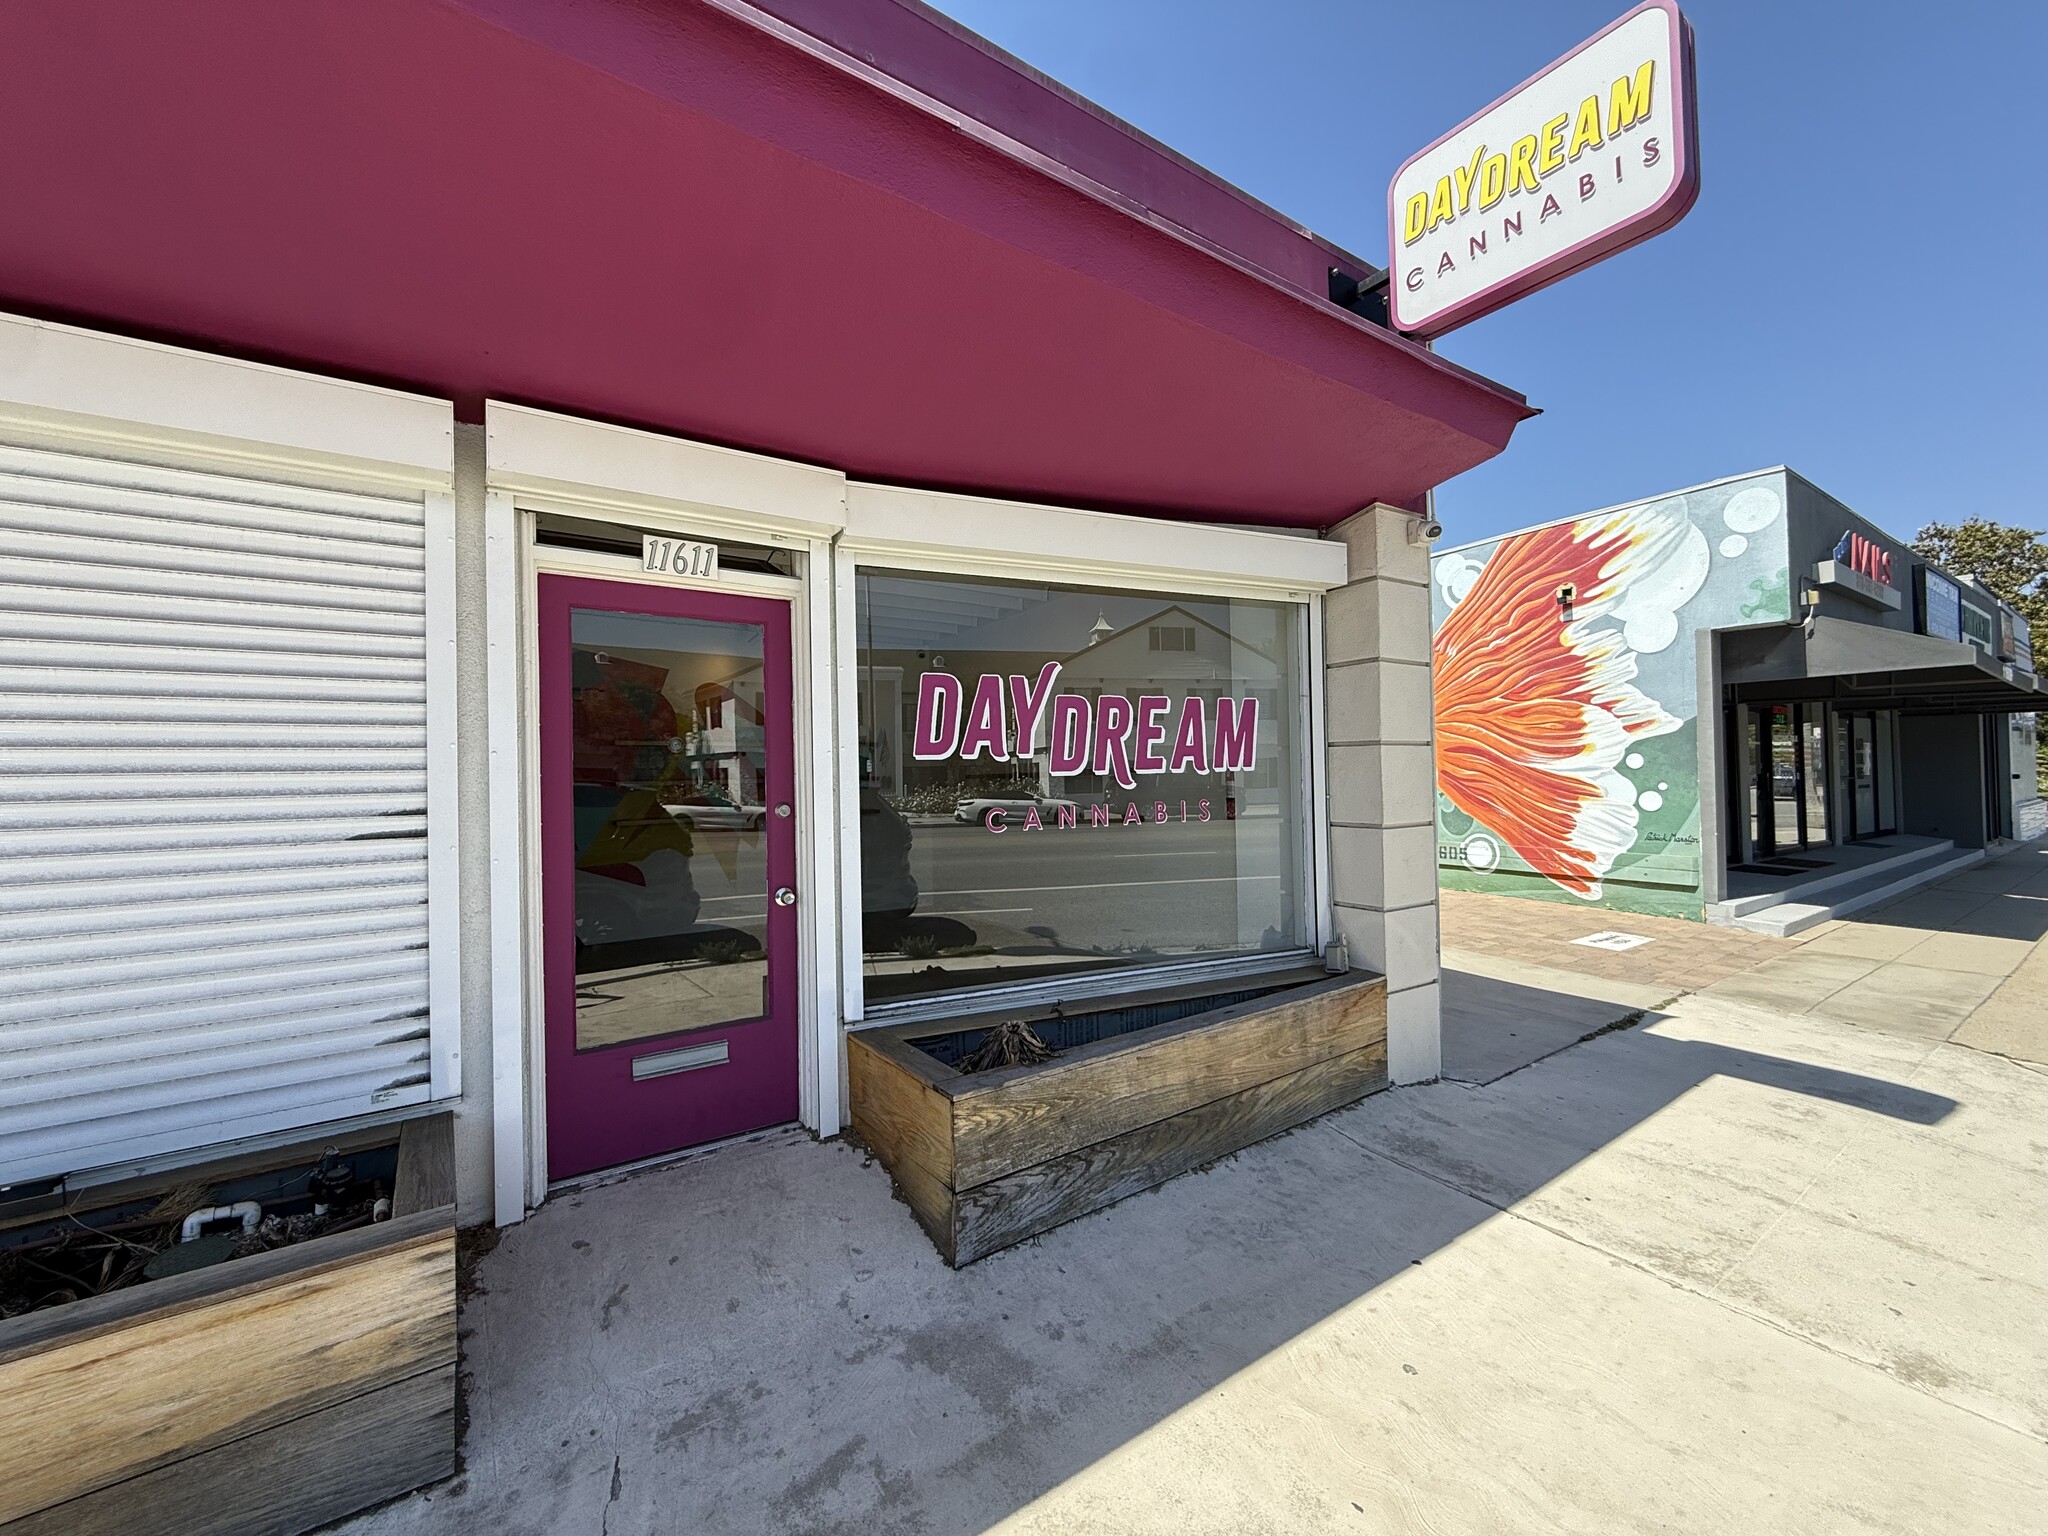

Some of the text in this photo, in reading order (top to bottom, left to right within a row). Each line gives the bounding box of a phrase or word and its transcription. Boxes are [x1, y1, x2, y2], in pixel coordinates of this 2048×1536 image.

[1404, 60, 1655, 247] DAYDREAM
[1406, 137, 1660, 290] CANNABIS
[646, 539, 715, 577] 11611
[913, 661, 1259, 790] DAYDREAM
[985, 798, 1211, 833] CANNABIS
